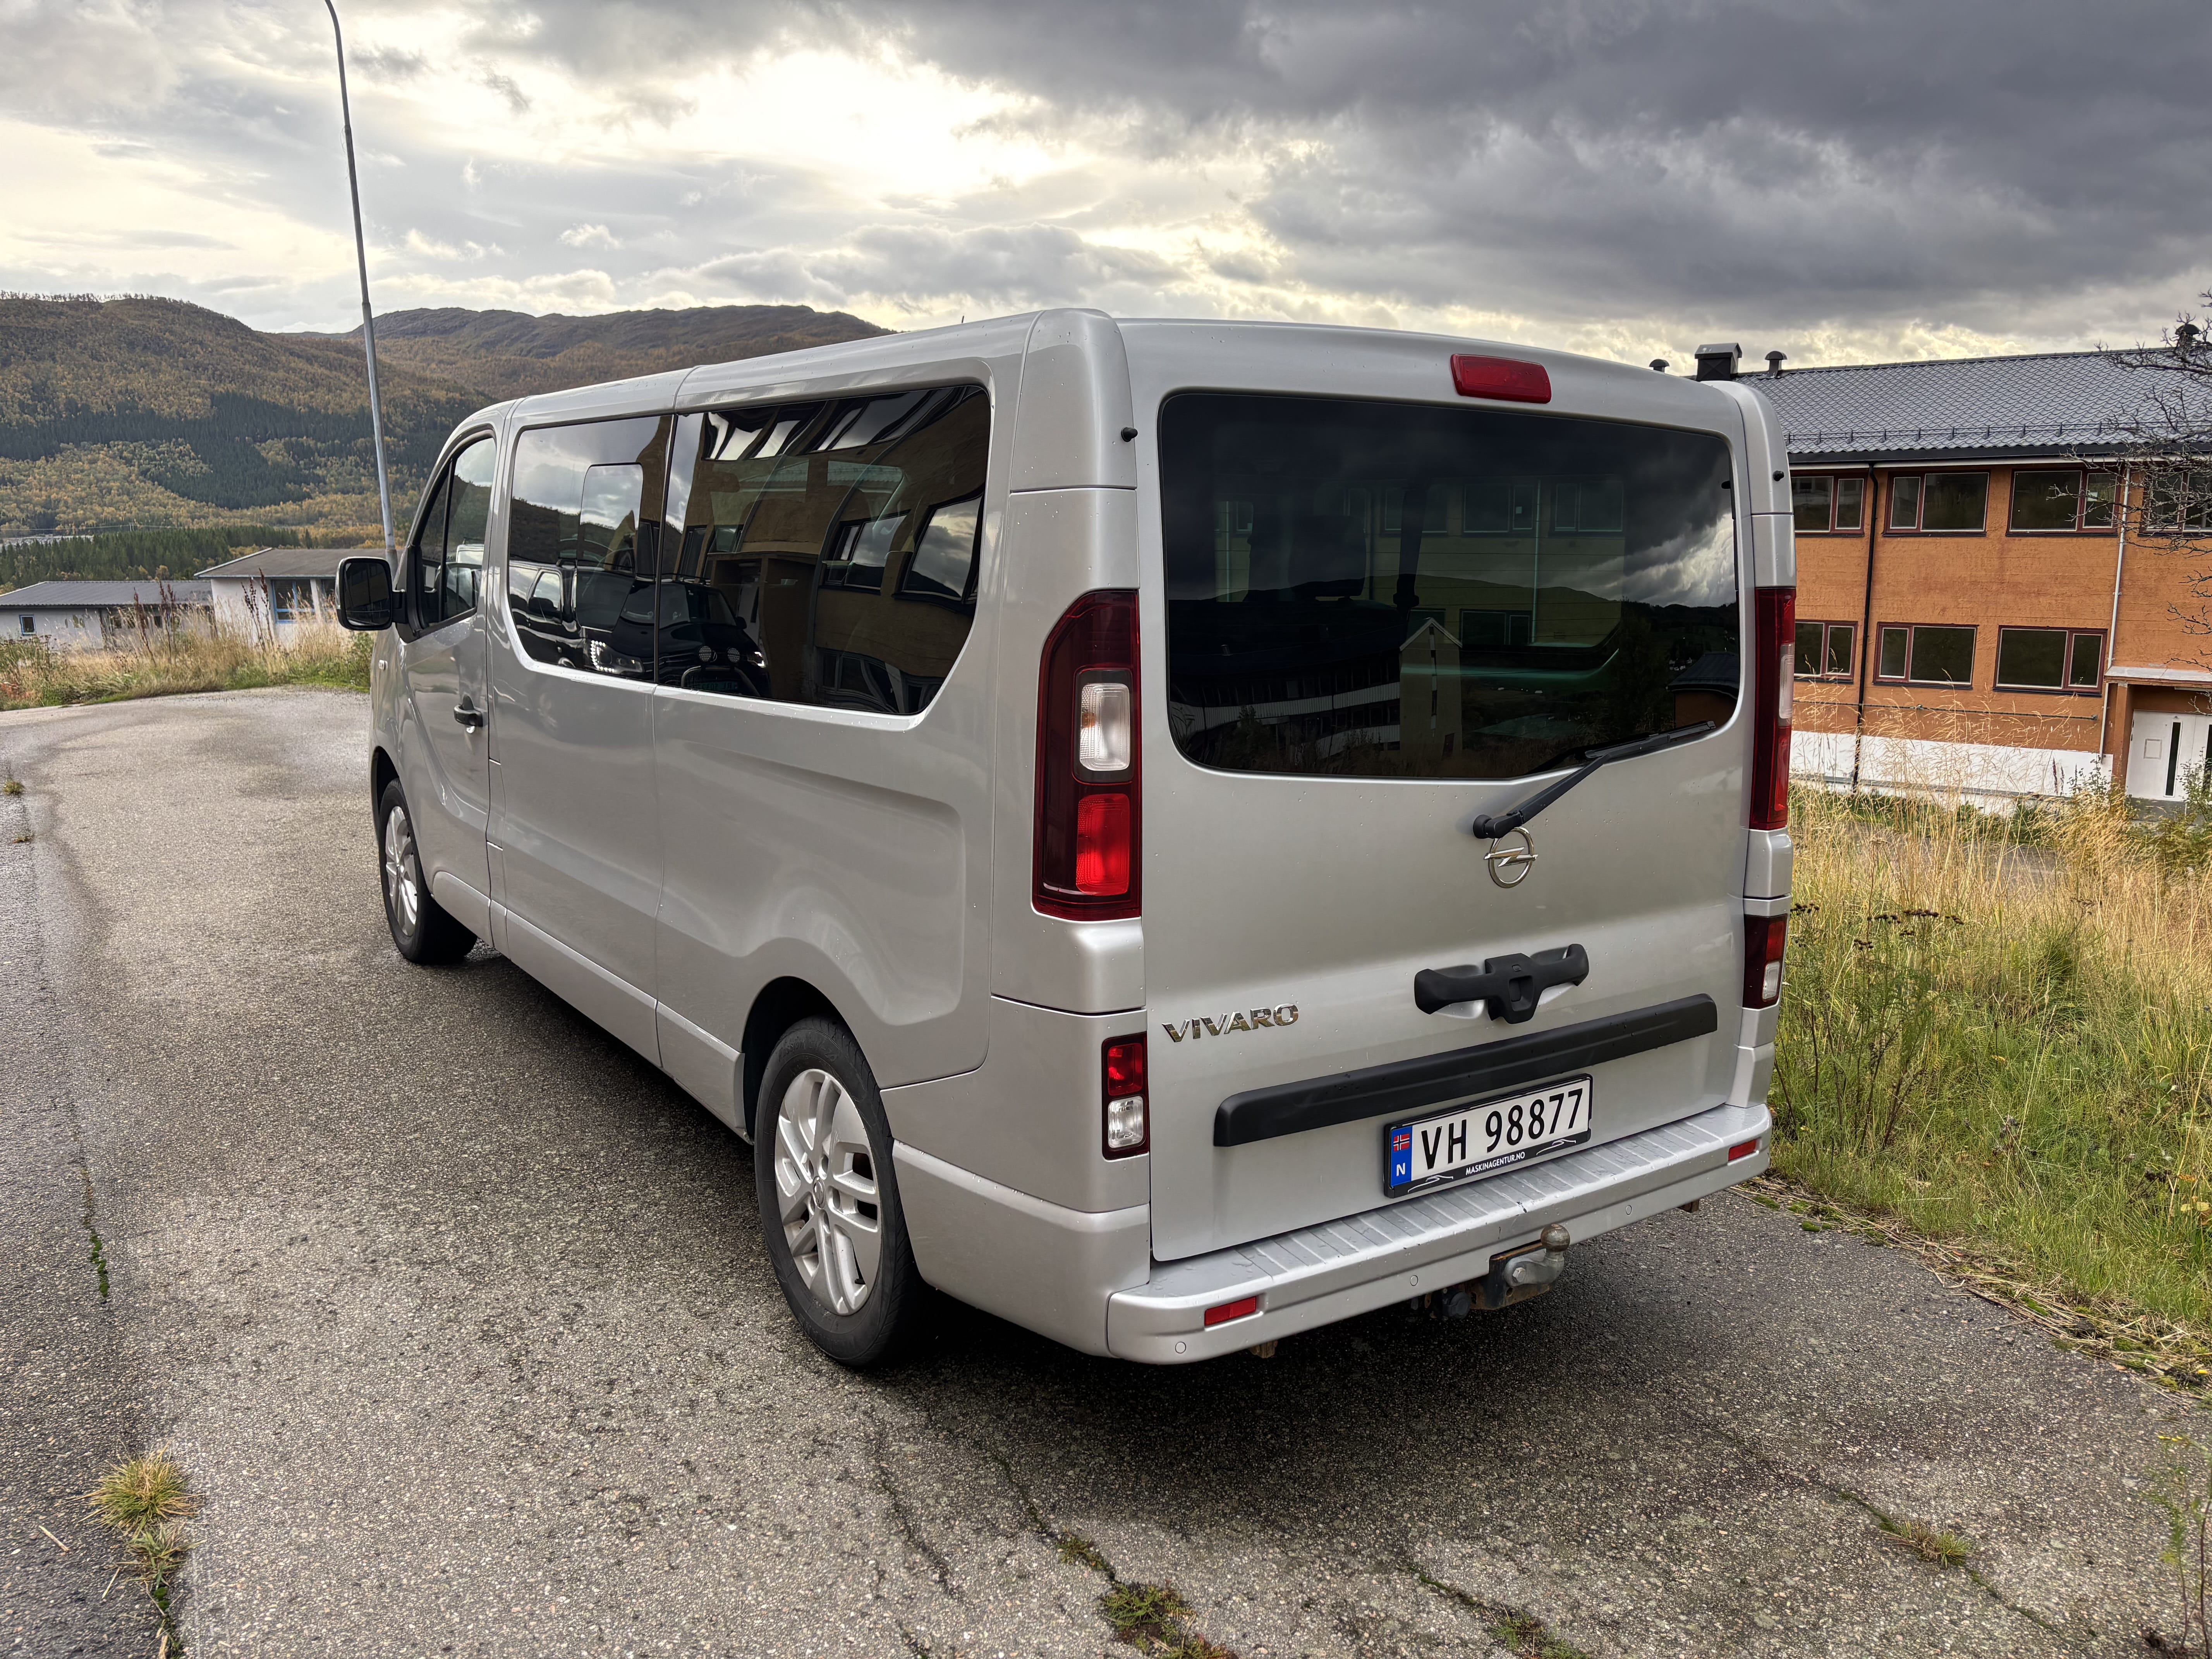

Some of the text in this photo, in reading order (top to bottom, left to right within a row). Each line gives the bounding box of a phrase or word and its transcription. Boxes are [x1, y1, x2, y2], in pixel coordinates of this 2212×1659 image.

[1161, 1003, 1299, 1042] VIVARO
[1421, 1088, 1583, 1170] VH 98877
[1396, 1163, 1406, 1176] N
[1465, 1151, 1525, 1176] MASKINAGENTUR.NO
